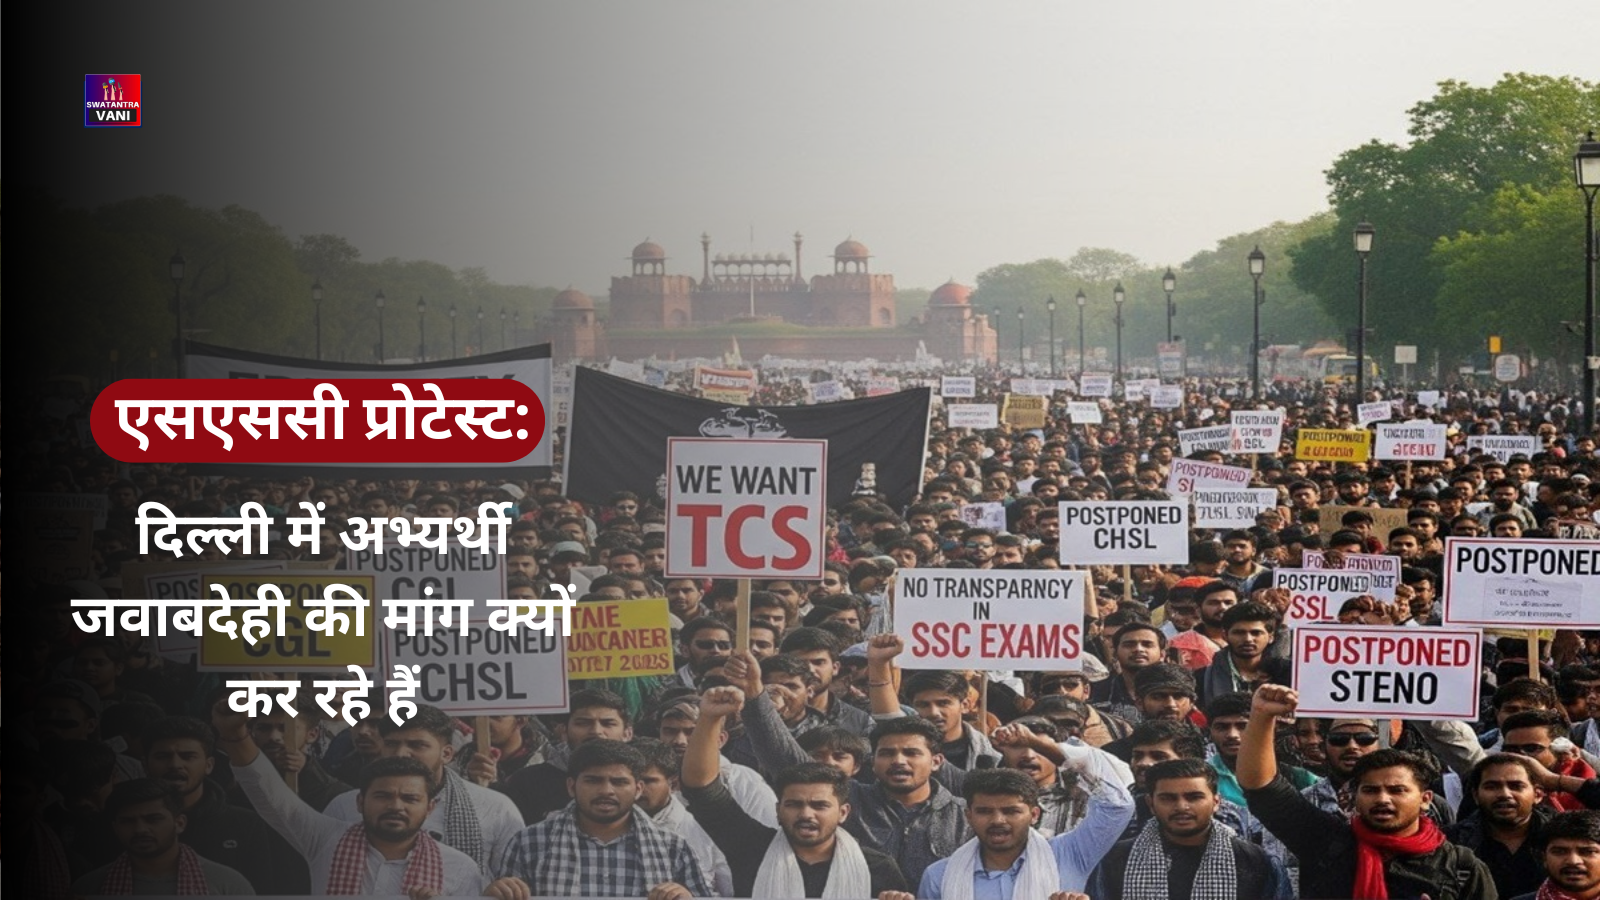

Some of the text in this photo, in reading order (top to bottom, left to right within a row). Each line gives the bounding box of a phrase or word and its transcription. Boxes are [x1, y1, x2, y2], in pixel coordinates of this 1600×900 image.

[676, 465, 817, 495] WE WANT
[1067, 506, 1182, 525] POSTPONED
[677, 504, 812, 571] TCS
[1094, 528, 1157, 549] CHSL
[356, 547, 497, 572] POSTPONED
[1457, 547, 1600, 575] POSTPONED
[904, 577, 1073, 599] NO TRANSPARNCY
[973, 601, 990, 620] IN
[1290, 595, 1334, 621] SSL
[394, 625, 557, 657] POSTPONED
[911, 622, 1081, 659] SSC EXAMS
[1304, 635, 1472, 667] POSTPONED
[420, 661, 527, 702] CHSL
[1330, 670, 1438, 704] STENO
